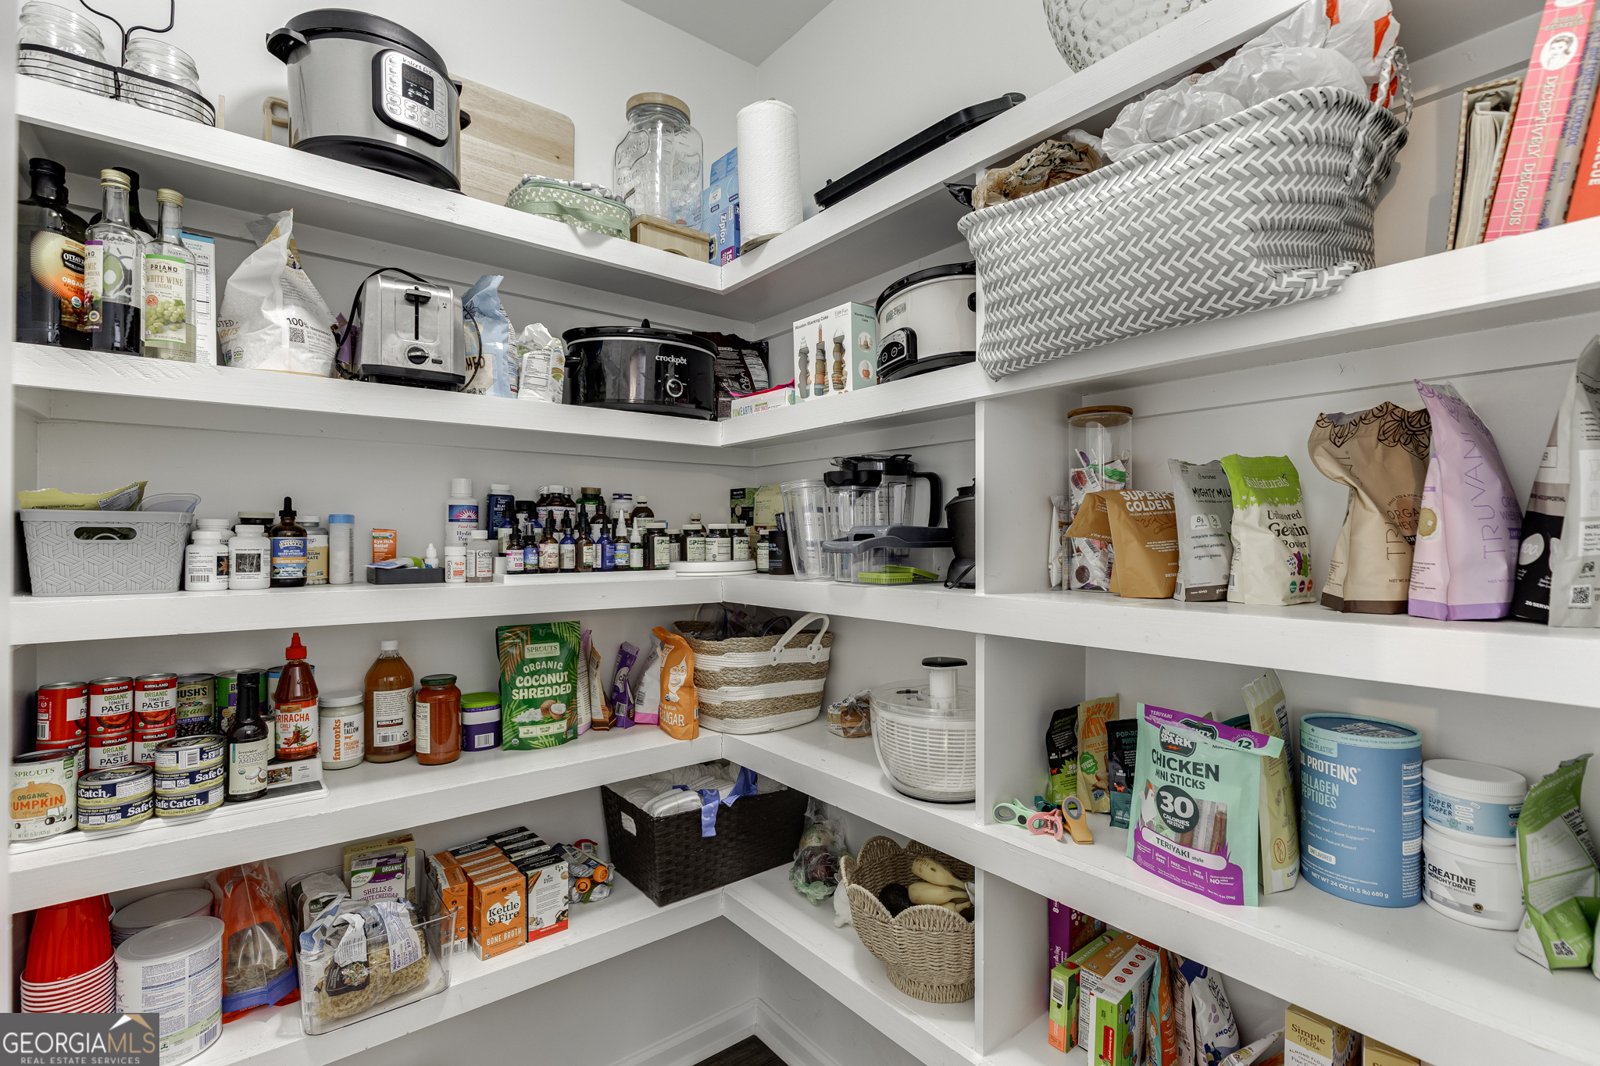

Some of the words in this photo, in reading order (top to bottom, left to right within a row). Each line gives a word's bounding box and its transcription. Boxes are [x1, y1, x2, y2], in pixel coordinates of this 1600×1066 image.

[1528, 75, 1558, 158] DECEPTIVELY
[1509, 163, 1536, 226] DELICIOUS
[719, 212, 727, 245] Ziploc
[150, 264, 178, 273] PRIANO
[166, 276, 184, 287] WINE
[656, 354, 688, 366] crockpot
[1192, 488, 1215, 498] MIGHTY
[1217, 488, 1231, 498] MIL
[1461, 431, 1507, 560] TRUVANI
[1126, 500, 1171, 512] GOLDEN
[527, 645, 558, 653] SPROUTS
[523, 661, 563, 674] ORGANIC
[515, 672, 569, 687] COCONUT
[104, 693, 128, 701] ORGANIC
[512, 683, 572, 700] SHREDDED
[102, 703, 130, 713] PASTE
[142, 700, 170, 709] PASTE
[333, 719, 341, 760] fatworks
[1161, 732, 1193, 749] SPARK
[1237, 739, 1252, 749] 12
[103, 745, 127, 754] ORGANIC
[100, 755, 128, 765] PASTE
[1152, 748, 1220, 782] CHICKEN
[14, 768, 55, 777] SPROUTS
[1307, 755, 1358, 785] PROTEINS
[195, 772, 216, 783] Safe
[1170, 773, 1206, 790] STICKS
[17, 792, 50, 801] ORGANIC
[1428, 796, 1452, 810] SUPER
[127, 801, 148, 816] Safe
[169, 799, 201, 810] Catch
[1159, 791, 1194, 819] 30
[1428, 803, 1453, 817] POOPER
[1163, 813, 1190, 827] CALORIES
[1155, 837, 1190, 859] TERIYAKI
[1311, 871, 1320, 879] NET
[1427, 863, 1476, 887] CREATINE
[1427, 871, 1476, 893] MONOHYDRATE
[363, 886, 387, 896] SHELLS
[488, 901, 520, 918] Kettle
[489, 917, 496, 926] &
[498, 911, 520, 923] Fire
[487, 935, 502, 946] BONE
[504, 927, 522, 940] BROTH
[1291, 1023, 1326, 1045] Simple
